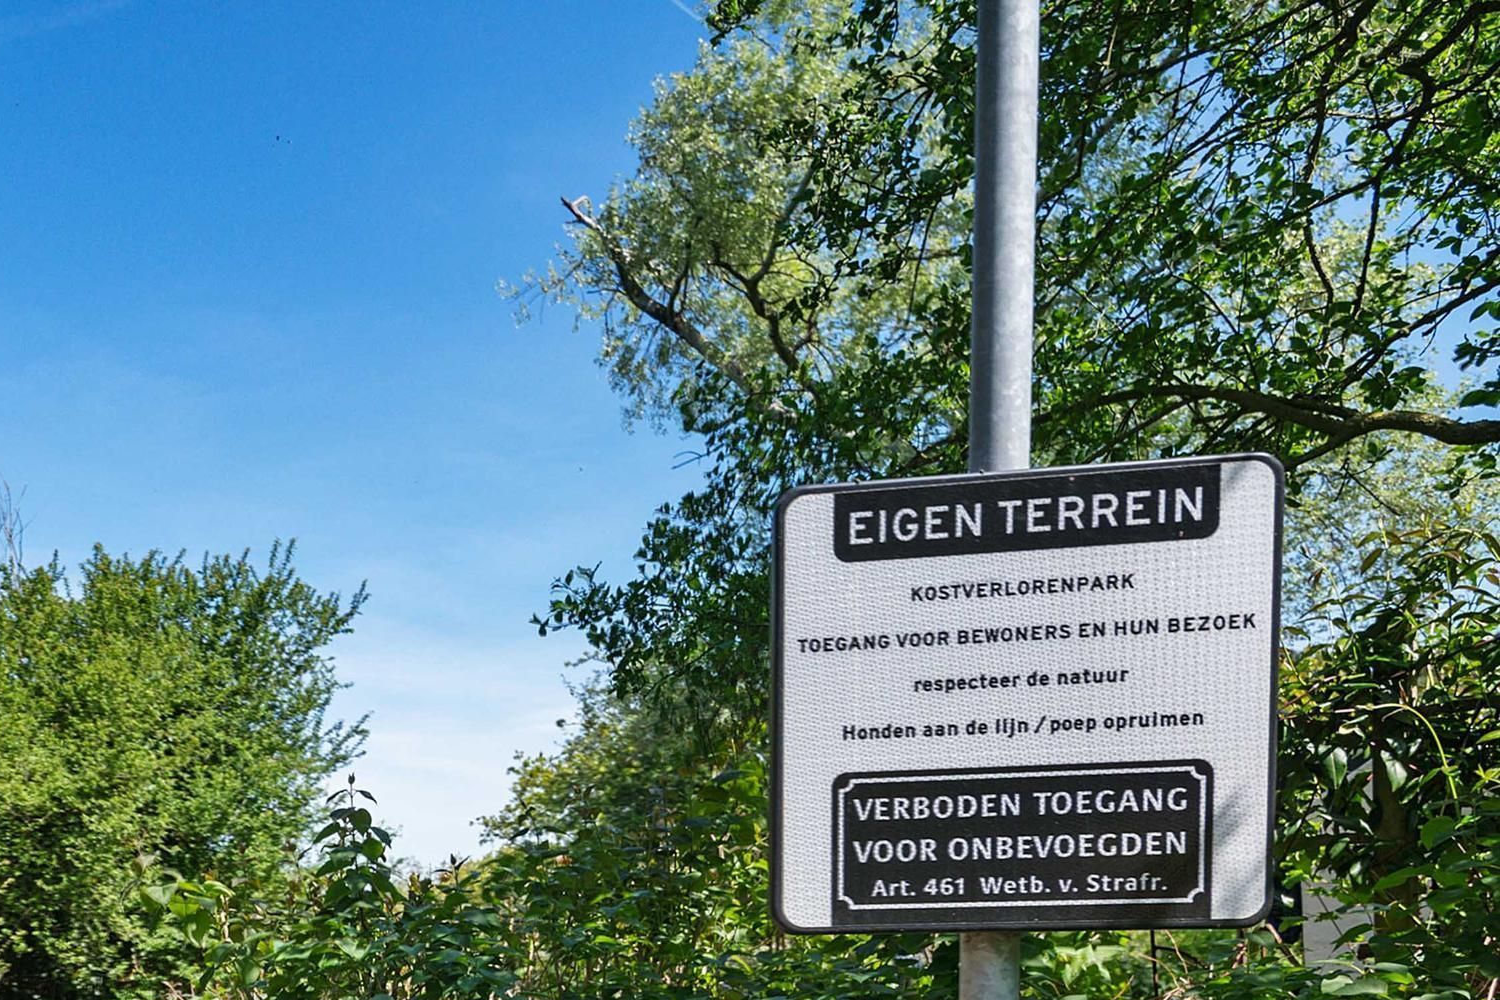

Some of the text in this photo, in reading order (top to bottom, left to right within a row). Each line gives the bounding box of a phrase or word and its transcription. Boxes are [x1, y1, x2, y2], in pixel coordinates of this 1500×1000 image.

[849, 486, 1203, 545] EIGEN TERREIN
[911, 573, 1135, 601] KOSTVERLORENPARK
[797, 613, 1256, 654] TOEGANG VOOR BEWONERS EN HUN BEZOEK
[913, 668, 1129, 694] respecteer de natuur
[842, 723, 916, 741] Honden
[922, 722, 958, 737] aan
[965, 720, 988, 736] de
[1103, 711, 1204, 730] opruimen
[852, 787, 1188, 822] VERBODEN TOEGANG
[852, 830, 1187, 863] VOOR ONBEVOEGDEN
[871, 873, 1168, 897] Art. 461 Wetb. v. Strafr.
